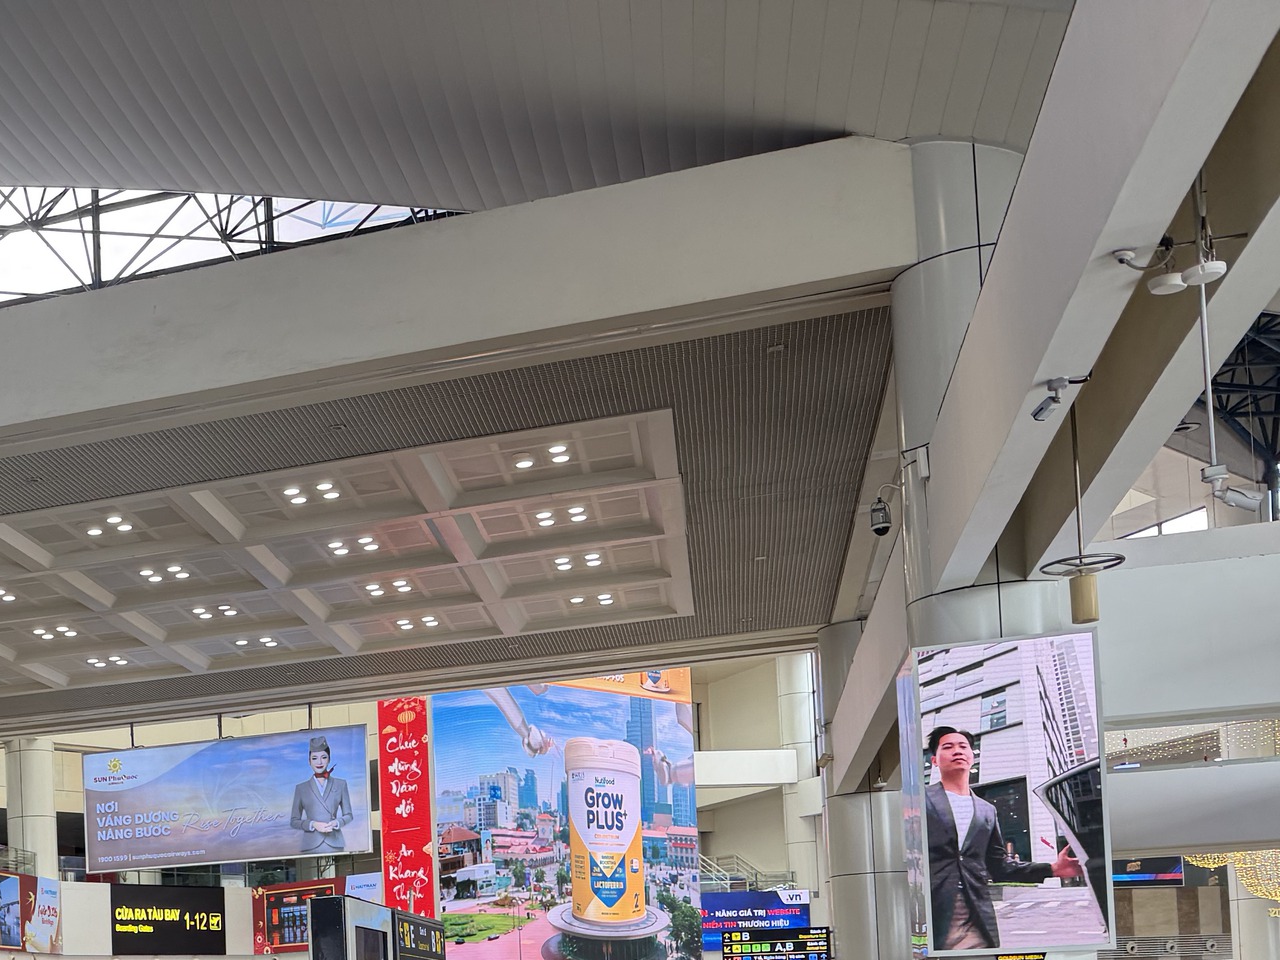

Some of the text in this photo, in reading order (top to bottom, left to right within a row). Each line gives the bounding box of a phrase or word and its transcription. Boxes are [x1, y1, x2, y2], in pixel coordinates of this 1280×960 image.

[93, 776, 108, 784] SUN
[96, 801, 118, 814] NƠI
[134, 810, 180, 824] DƯƠNG
[181, 805, 287, 838] Rise Together
[388, 865, 430, 888] Khang
[785, 892, 802, 901] .vn
[115, 905, 208, 930] CỬA RA TÀU BAY 1-12
[738, 907, 753, 917] GIÁ
[767, 908, 801, 916] WEBSITE
[742, 932, 751, 941] B
[775, 942, 794, 953] A,B
